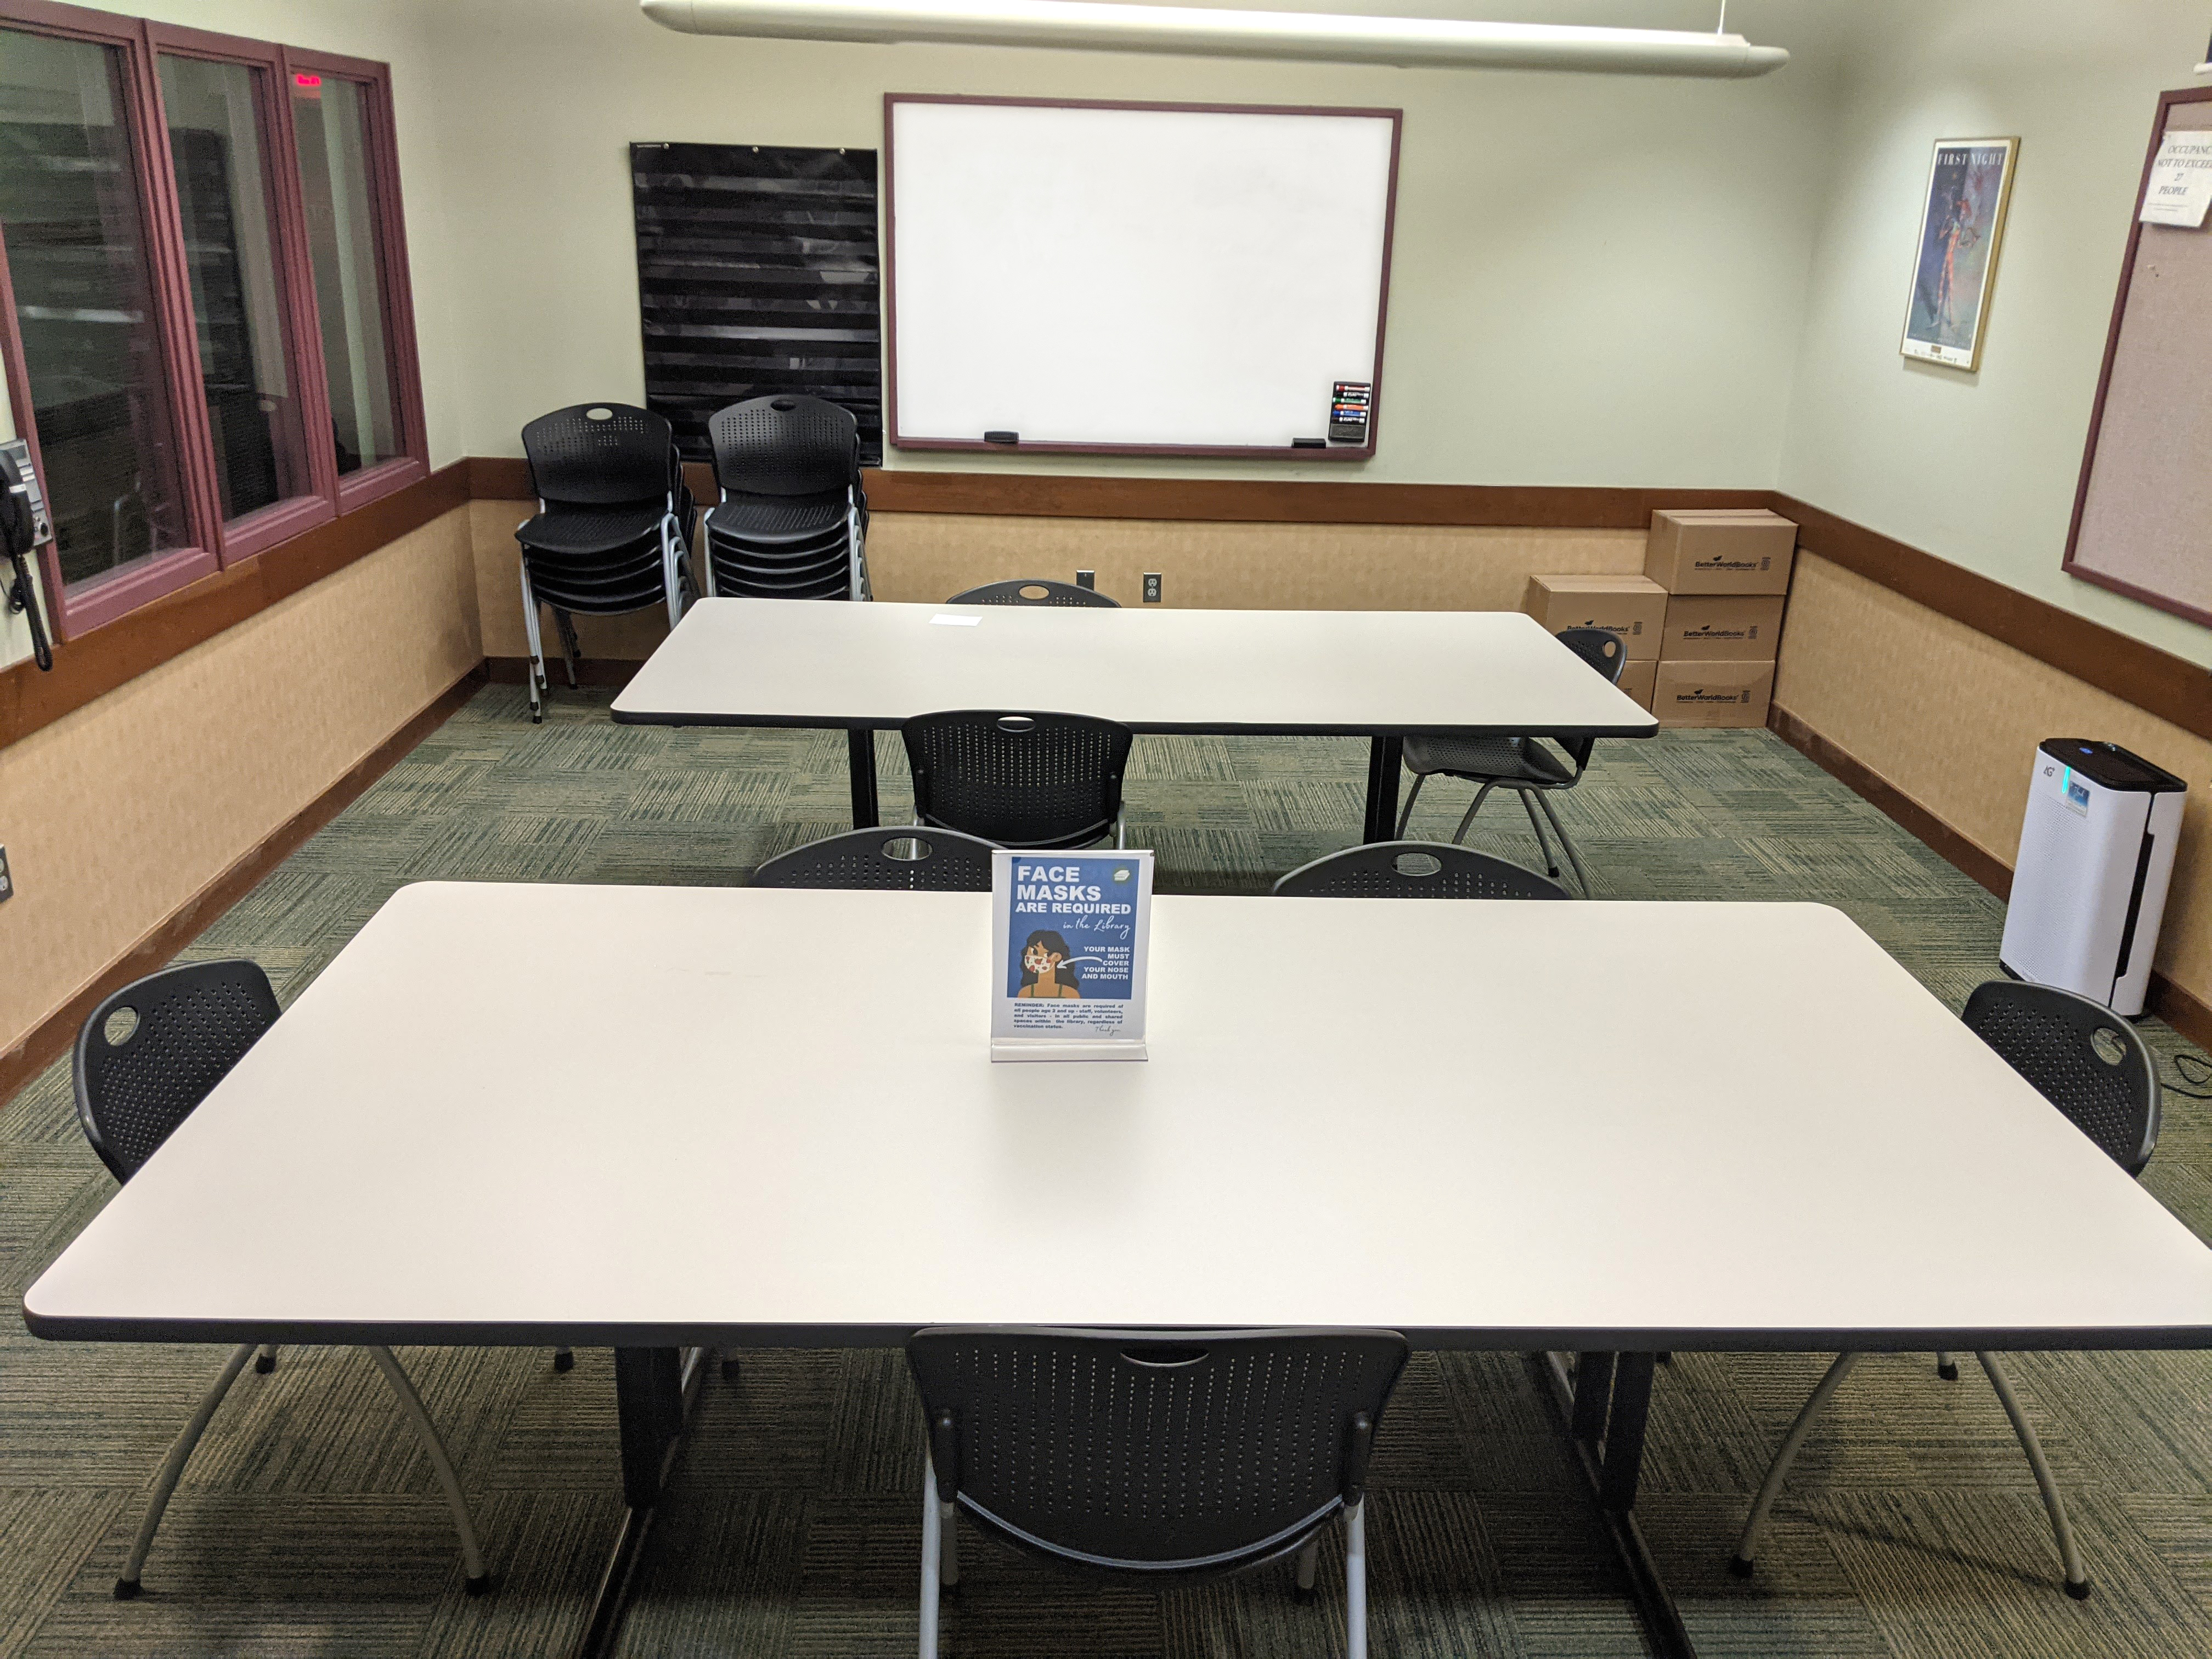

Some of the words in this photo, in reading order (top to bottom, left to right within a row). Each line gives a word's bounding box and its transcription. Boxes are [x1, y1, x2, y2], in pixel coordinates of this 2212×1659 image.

[2168, 145, 2212, 154] OCCUPANC
[1938, 153, 1967, 165] FIRST
[1971, 153, 2001, 165] NIGHT
[2173, 159, 2185, 167] TO
[2185, 160, 2212, 168] EXCEE
[2159, 186, 2188, 195] PEOPLE
[1018, 866, 1080, 882] FACE
[1017, 884, 1101, 901] MASKS
[1015, 902, 1047, 913] ARE
[1052, 903, 1131, 914] REQUIRED
[1075, 915, 1090, 929] the
[1093, 915, 1131, 939] Library
